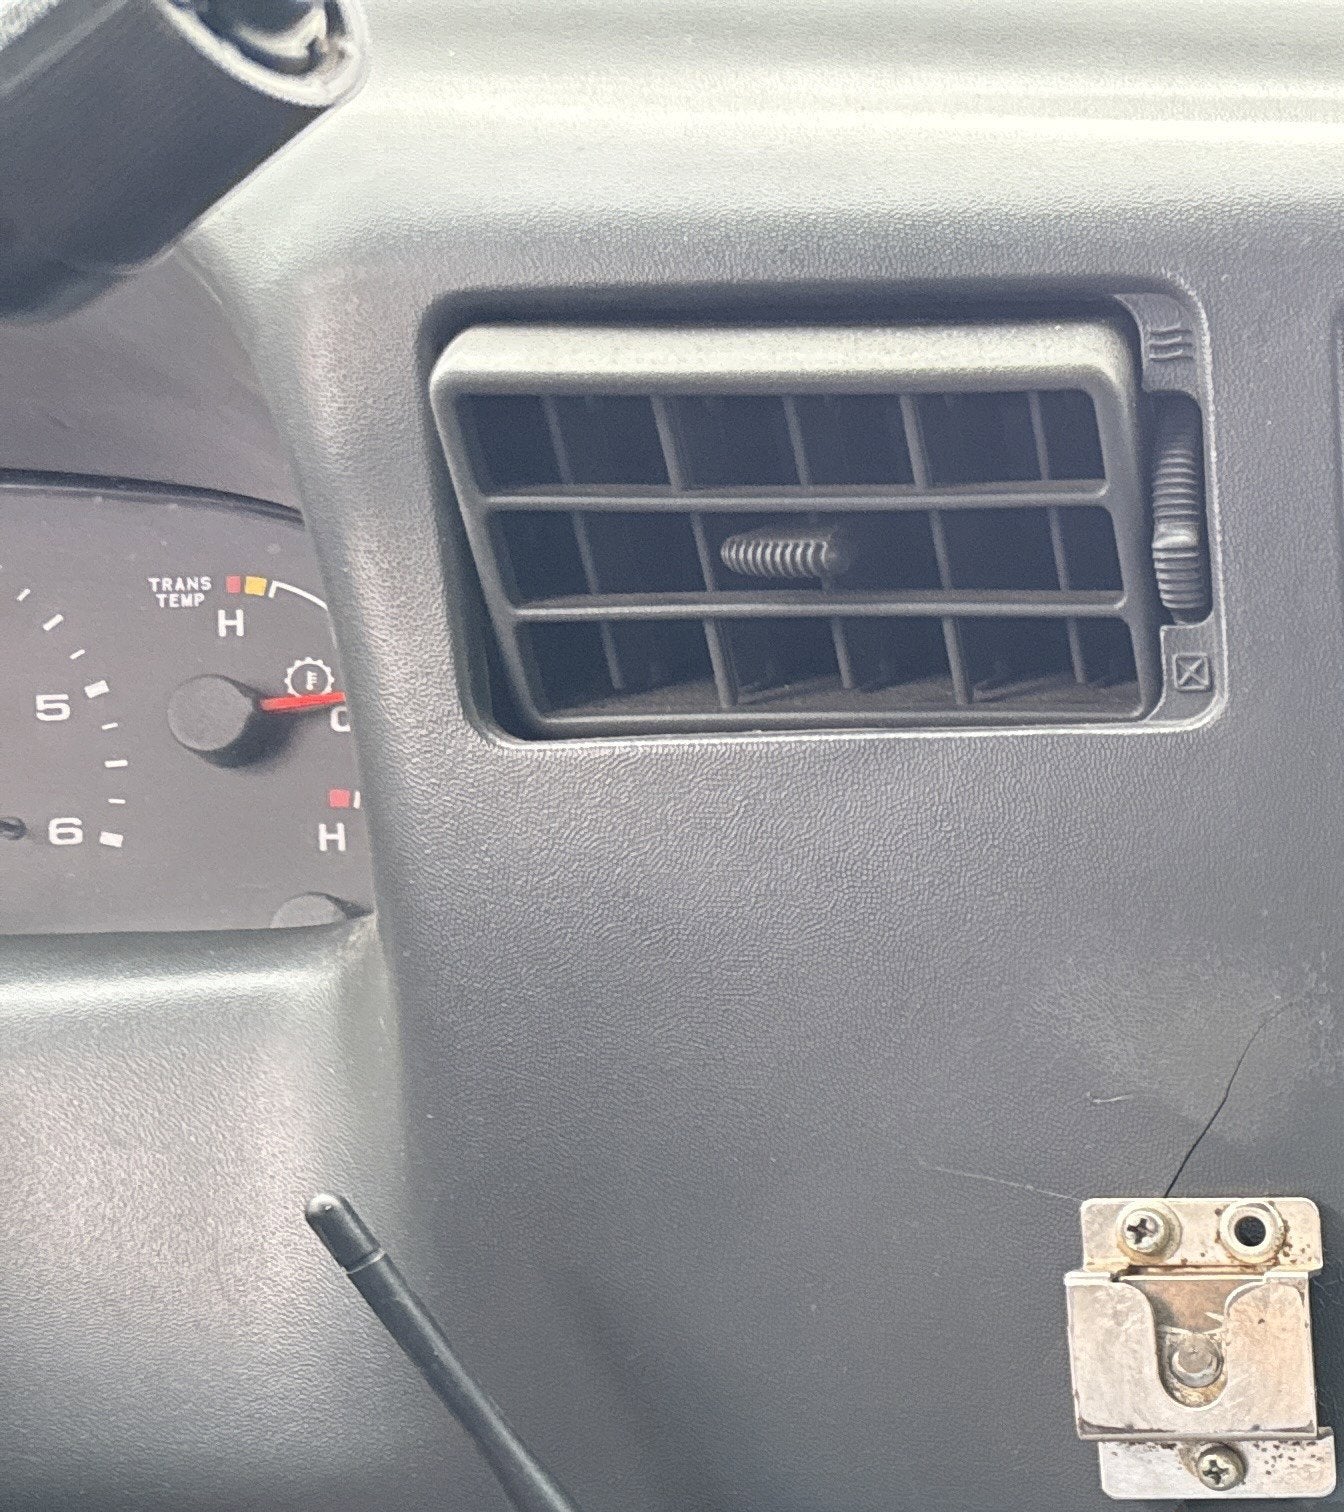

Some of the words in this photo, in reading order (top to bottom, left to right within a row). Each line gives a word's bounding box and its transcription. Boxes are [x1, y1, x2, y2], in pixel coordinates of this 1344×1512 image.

[148, 577, 212, 592] TRANS
[155, 593, 206, 608] TEMP
[218, 609, 246, 638] H
[35, 694, 72, 722] 5
[48, 817, 84, 846] 6
[318, 823, 347, 852] H
